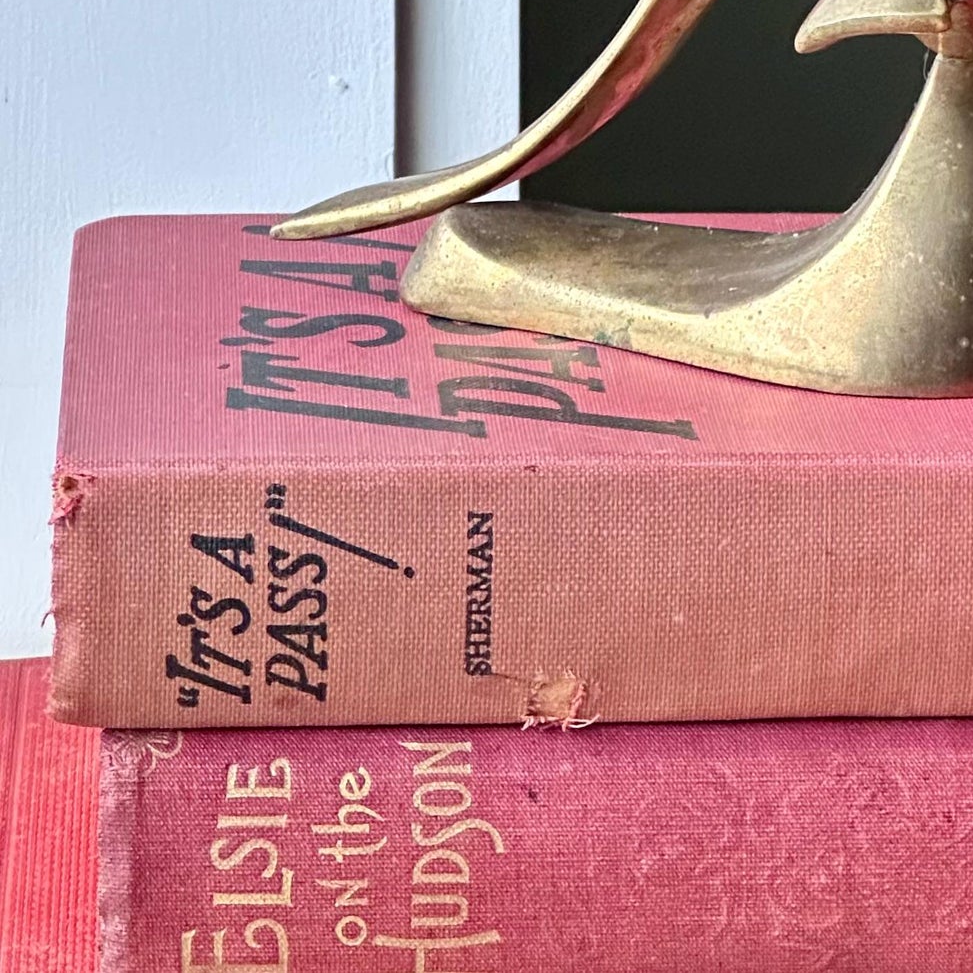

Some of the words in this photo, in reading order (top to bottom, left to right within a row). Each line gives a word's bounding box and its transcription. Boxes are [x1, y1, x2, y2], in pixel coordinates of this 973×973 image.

[239, 259, 401, 303] A
[219, 305, 488, 438] IT'S
[191, 533, 255, 584] A
[463, 509, 495, 677] SHERMAN
[165, 585, 252, 708] "IT'S
[180, 756, 294, 973] ELSIE
[311, 765, 388, 863] the
